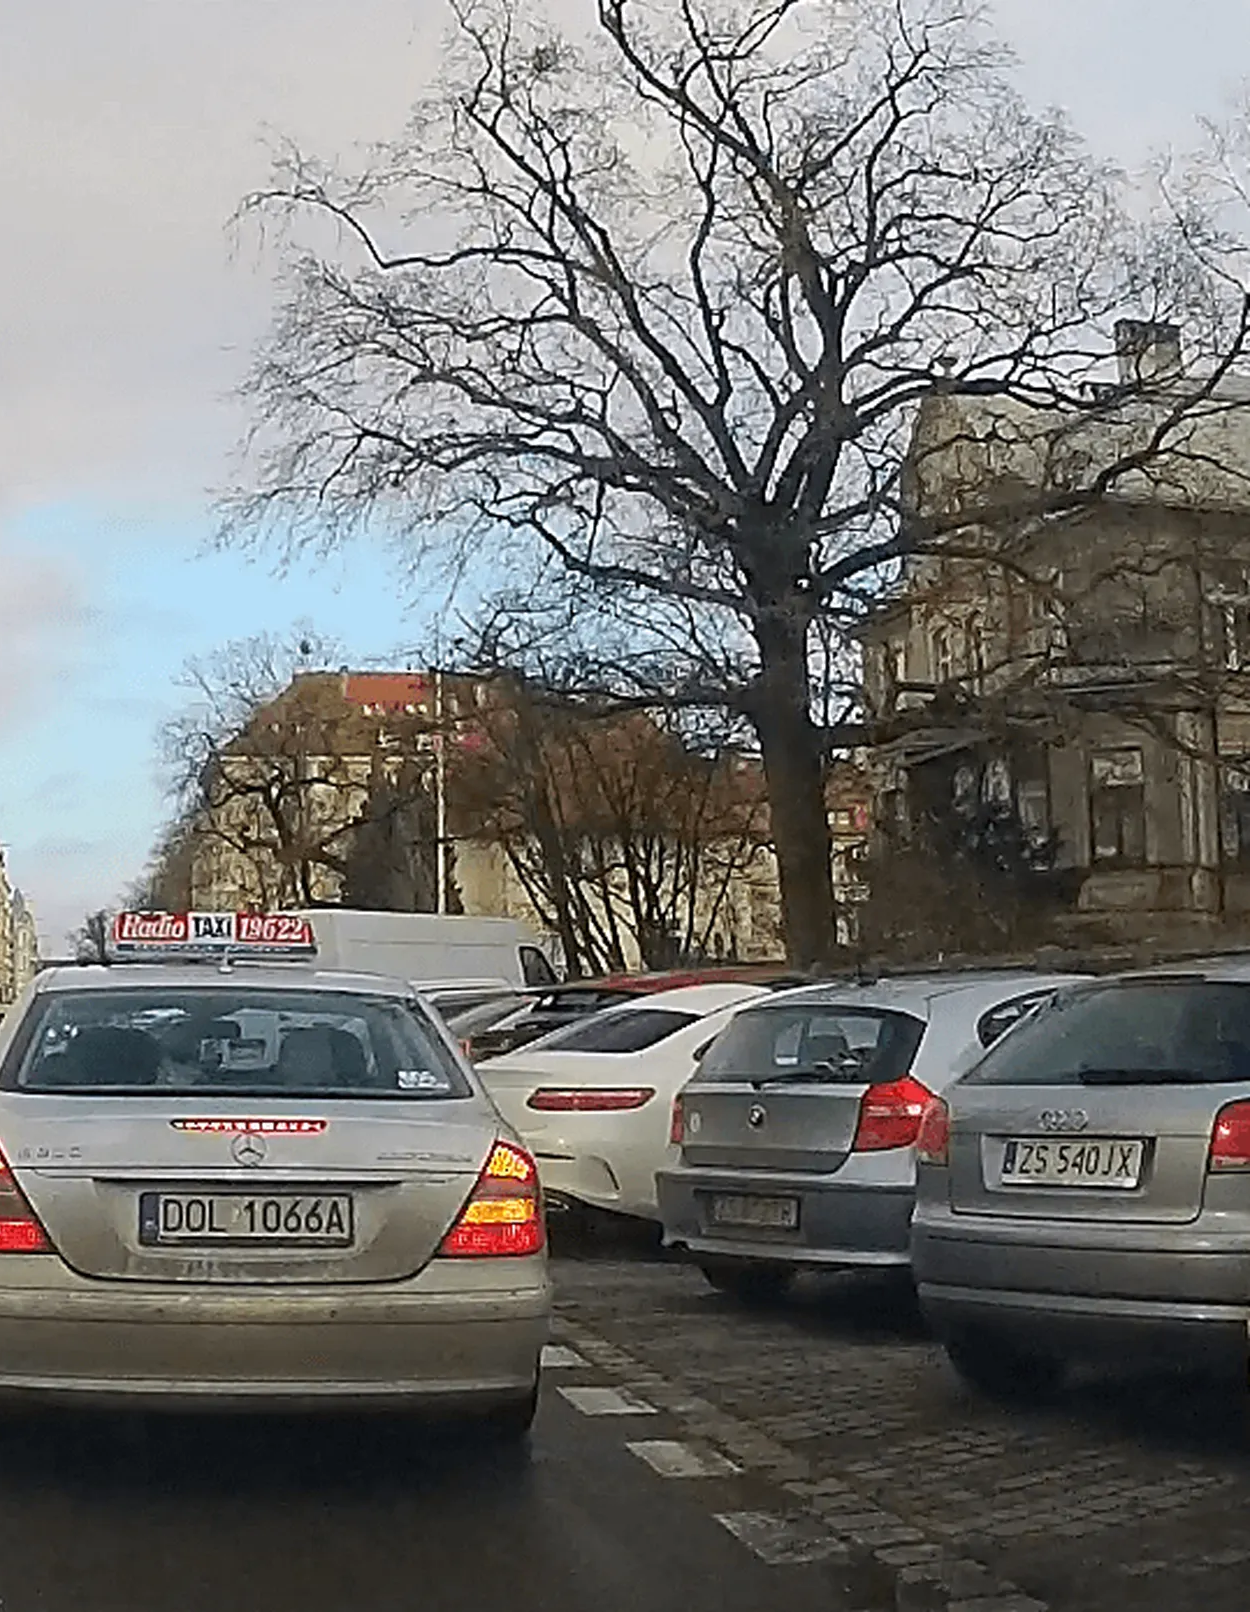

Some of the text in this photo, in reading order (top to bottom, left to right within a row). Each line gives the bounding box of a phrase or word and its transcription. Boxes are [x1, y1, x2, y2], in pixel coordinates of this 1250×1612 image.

[122, 914, 185, 939] Radio
[193, 916, 232, 938] TAXI
[1018, 1145, 1132, 1177] ZS 540JX
[163, 1199, 345, 1234] DOL 1066A
